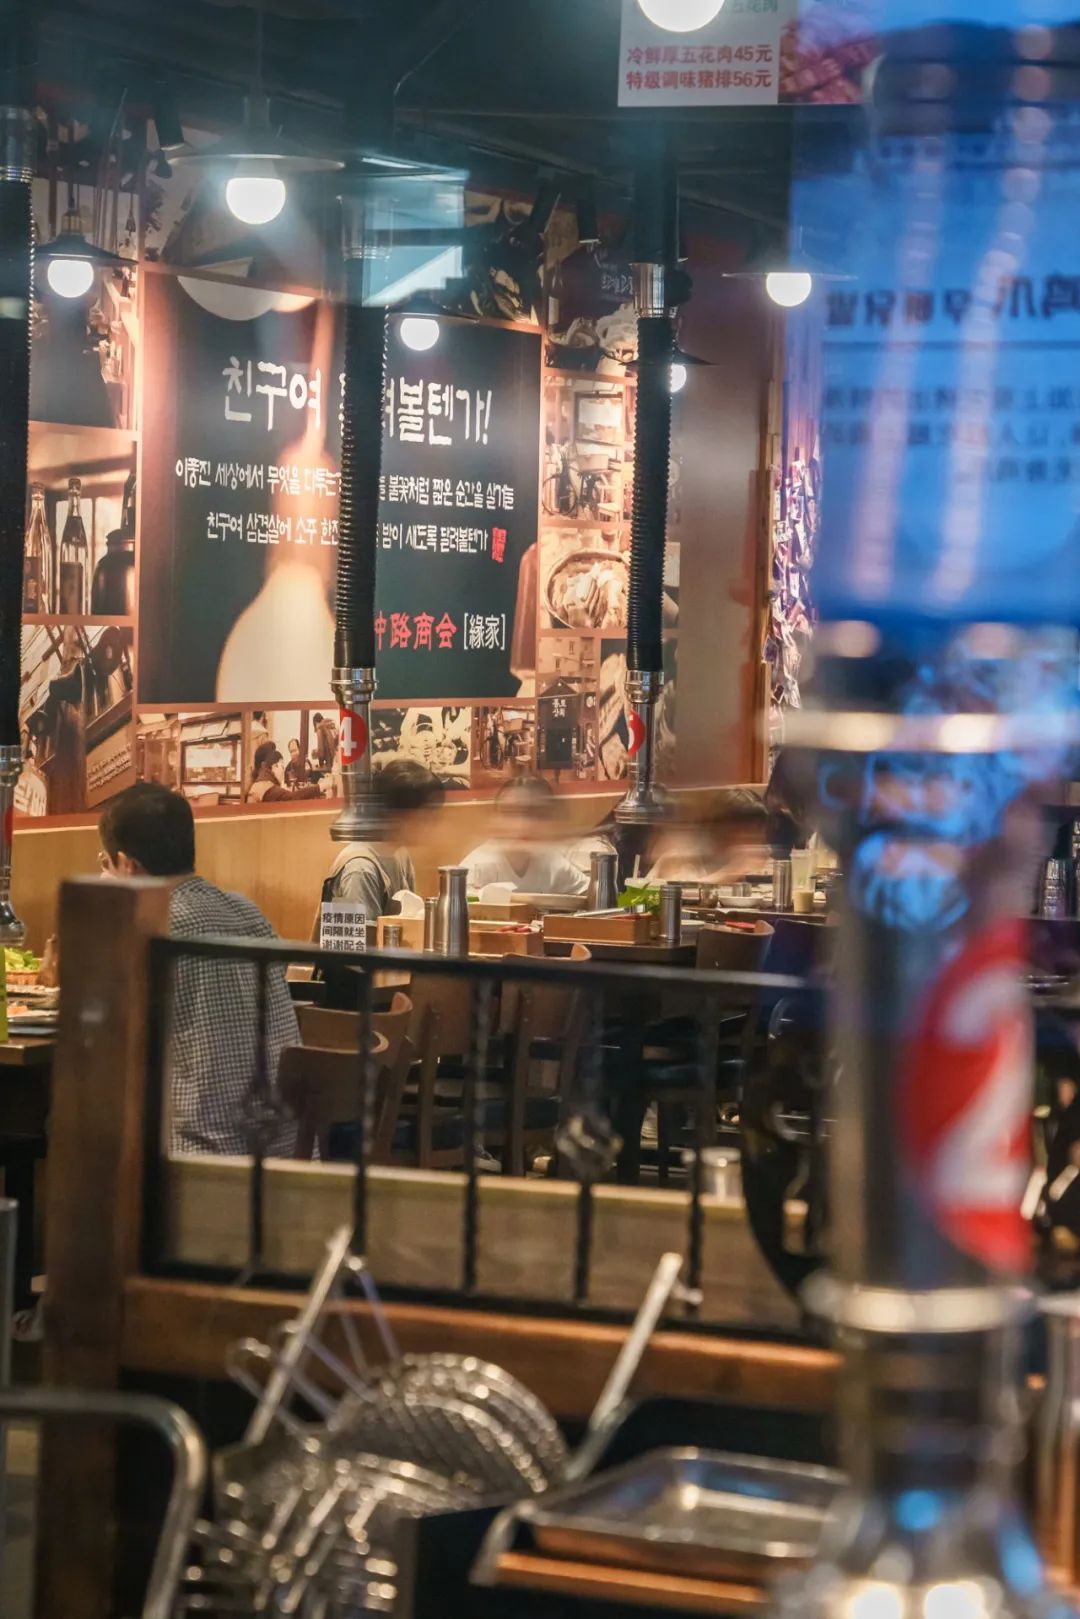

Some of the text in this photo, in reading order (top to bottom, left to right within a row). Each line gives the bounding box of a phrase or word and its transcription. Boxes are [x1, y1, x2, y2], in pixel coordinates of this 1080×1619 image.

[222, 356, 322, 431] 친구여
[175, 457, 211, 489] 이풍진
[214, 462, 264, 491] 세상에서
[266, 465, 301, 496] 무엇을
[388, 474, 429, 506] 불꽃처럼
[432, 478, 453, 506] 짧은
[456, 479, 483, 508] 순간을
[206, 511, 243, 542] 친구여
[246, 512, 292, 544] 삼겹살에
[294, 516, 318, 544] 소주
[382, 522, 403, 550] 밤이
[405, 523, 438, 552] 새도록
[439, 526, 489, 553] 달려볼텐가
[338, 716, 358, 757] 4
[322, 912, 365, 925] 疫情原因
[322, 926, 365, 938] 间隔就坐
[322, 939, 366, 952] 谢谢配合
